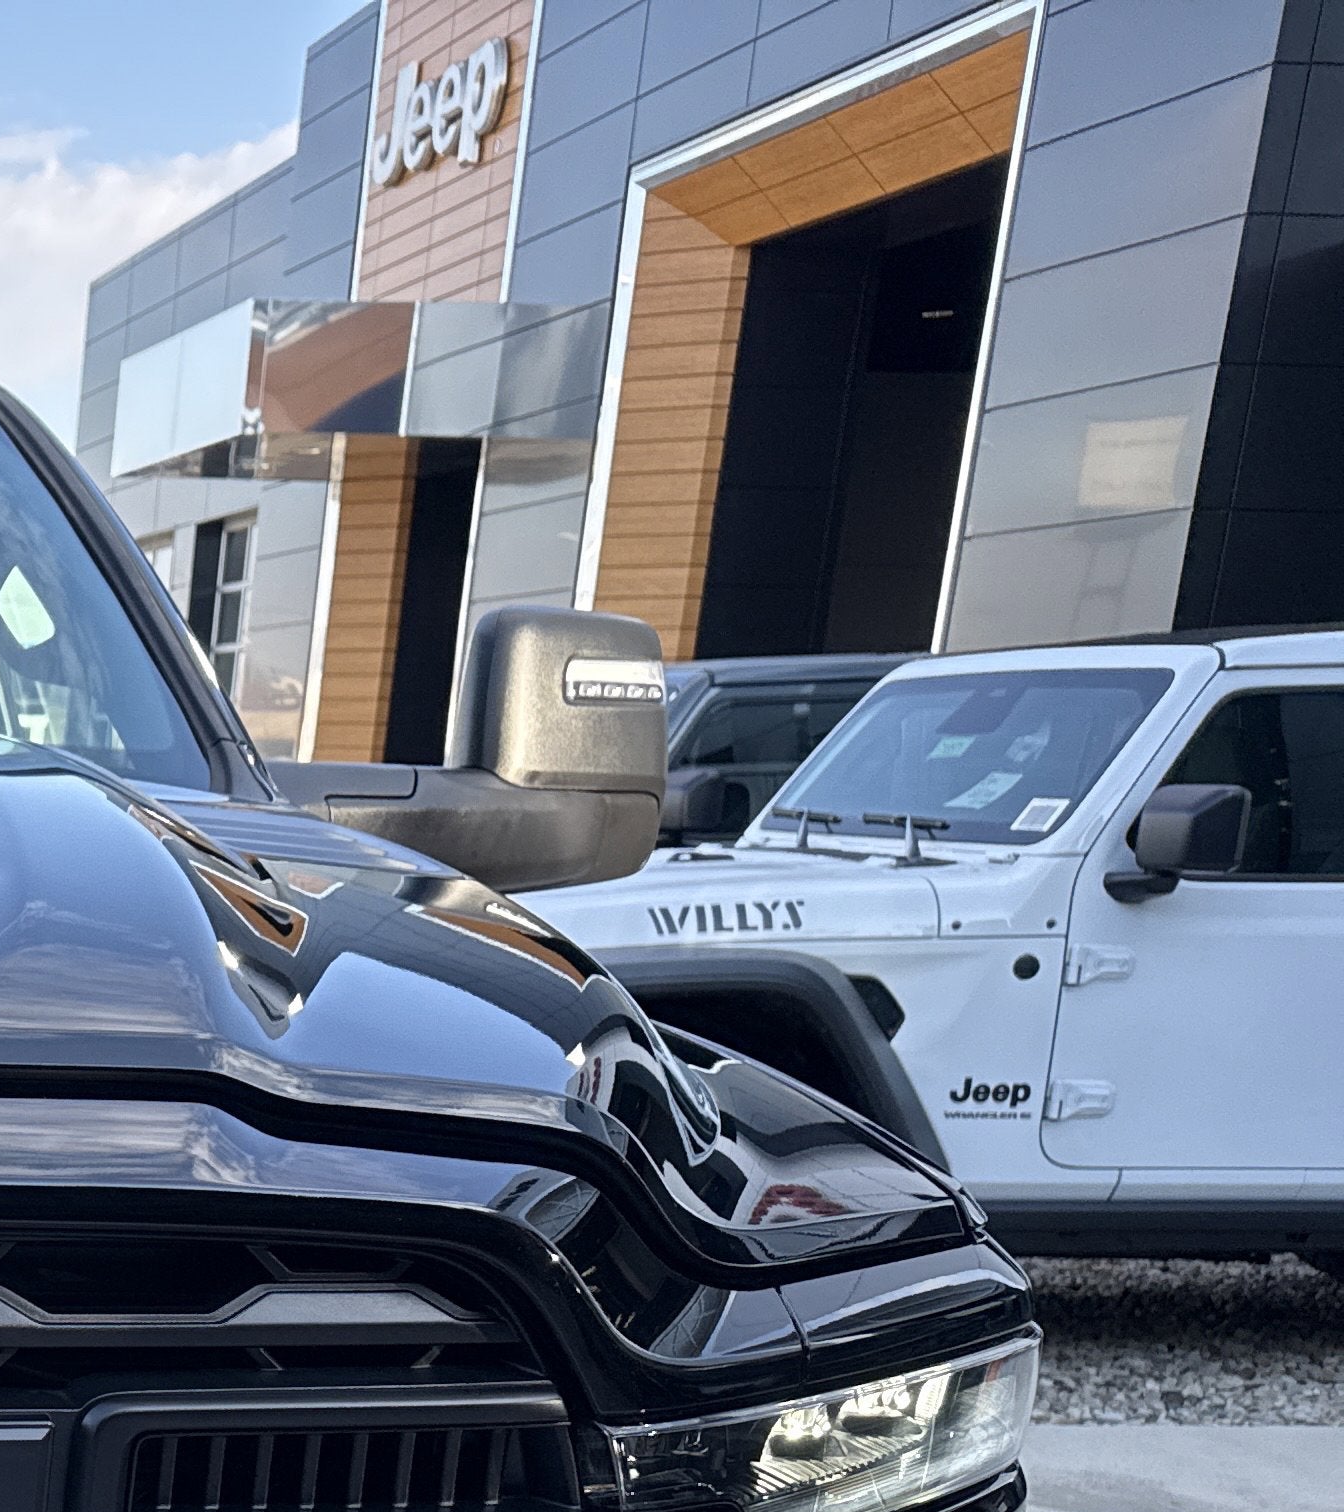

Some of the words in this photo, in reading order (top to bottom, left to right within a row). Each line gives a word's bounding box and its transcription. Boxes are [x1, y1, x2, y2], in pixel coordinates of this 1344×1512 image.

[372, 37, 508, 187] Jeep
[647, 901, 805, 936] WILLYS
[949, 1076, 1032, 1109] Jeep
